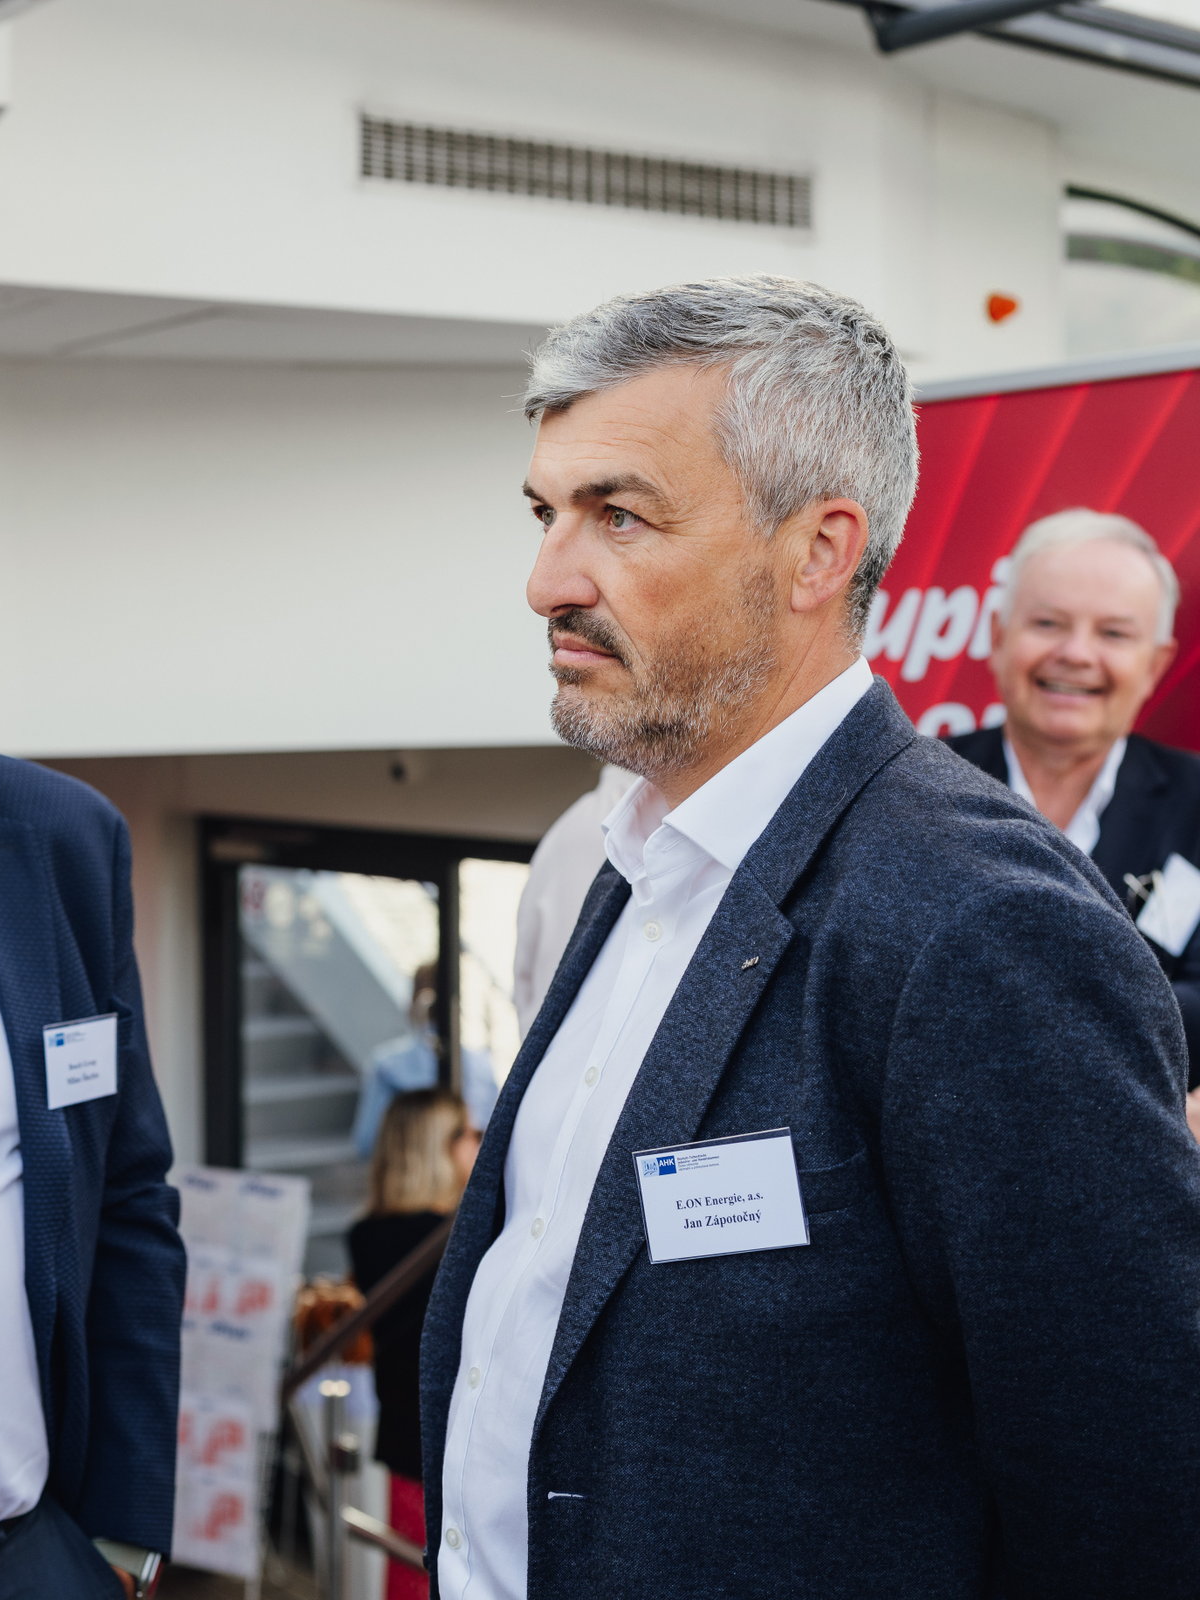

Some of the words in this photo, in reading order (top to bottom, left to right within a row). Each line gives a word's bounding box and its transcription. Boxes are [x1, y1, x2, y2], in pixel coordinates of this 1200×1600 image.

[658, 1158, 675, 1167] AHK
[676, 1198, 702, 1210] E.ON
[705, 1193, 745, 1206] Energie,
[747, 1192, 764, 1201] a.s.
[683, 1218, 702, 1230] Jan
[705, 1209, 762, 1228] Zápotočný
